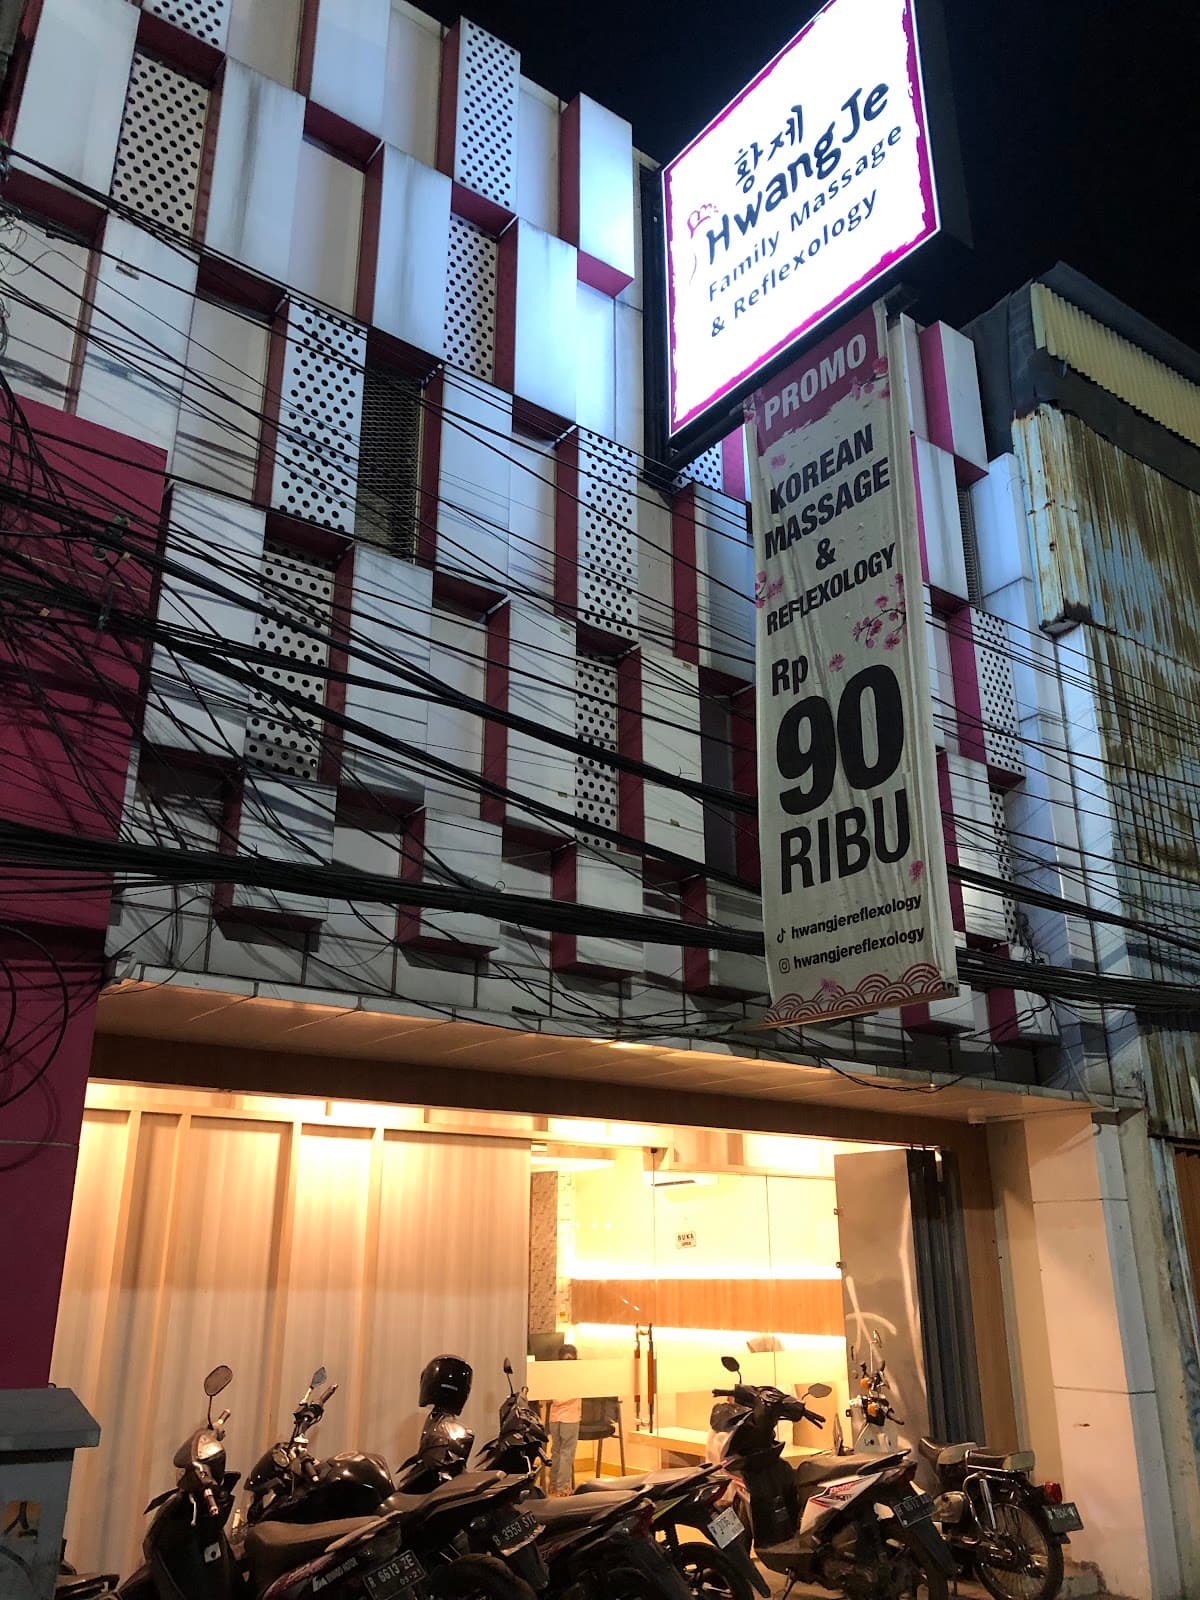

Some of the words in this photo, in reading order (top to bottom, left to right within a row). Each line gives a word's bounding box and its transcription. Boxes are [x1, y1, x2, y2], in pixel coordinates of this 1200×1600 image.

[734, 104, 804, 194] 황제
[709, 231, 780, 302] Family
[790, 126, 902, 233] Massage
[711, 317, 725, 338] &
[733, 189, 877, 319] Reflexology
[764, 334, 867, 431] PROMO
[764, 456, 892, 561] MASSAGE
[769, 423, 875, 515] KOREAN
[766, 542, 897, 636] REFLEXOLOGY
[815, 537, 837, 571] &
[771, 655, 809, 697] Rp
[776, 664, 905, 816] 90
[780, 787, 911, 896] RIBU
[791, 894, 922, 940] hwangjereflexology
[793, 926, 925, 970] hwangjereflexology
